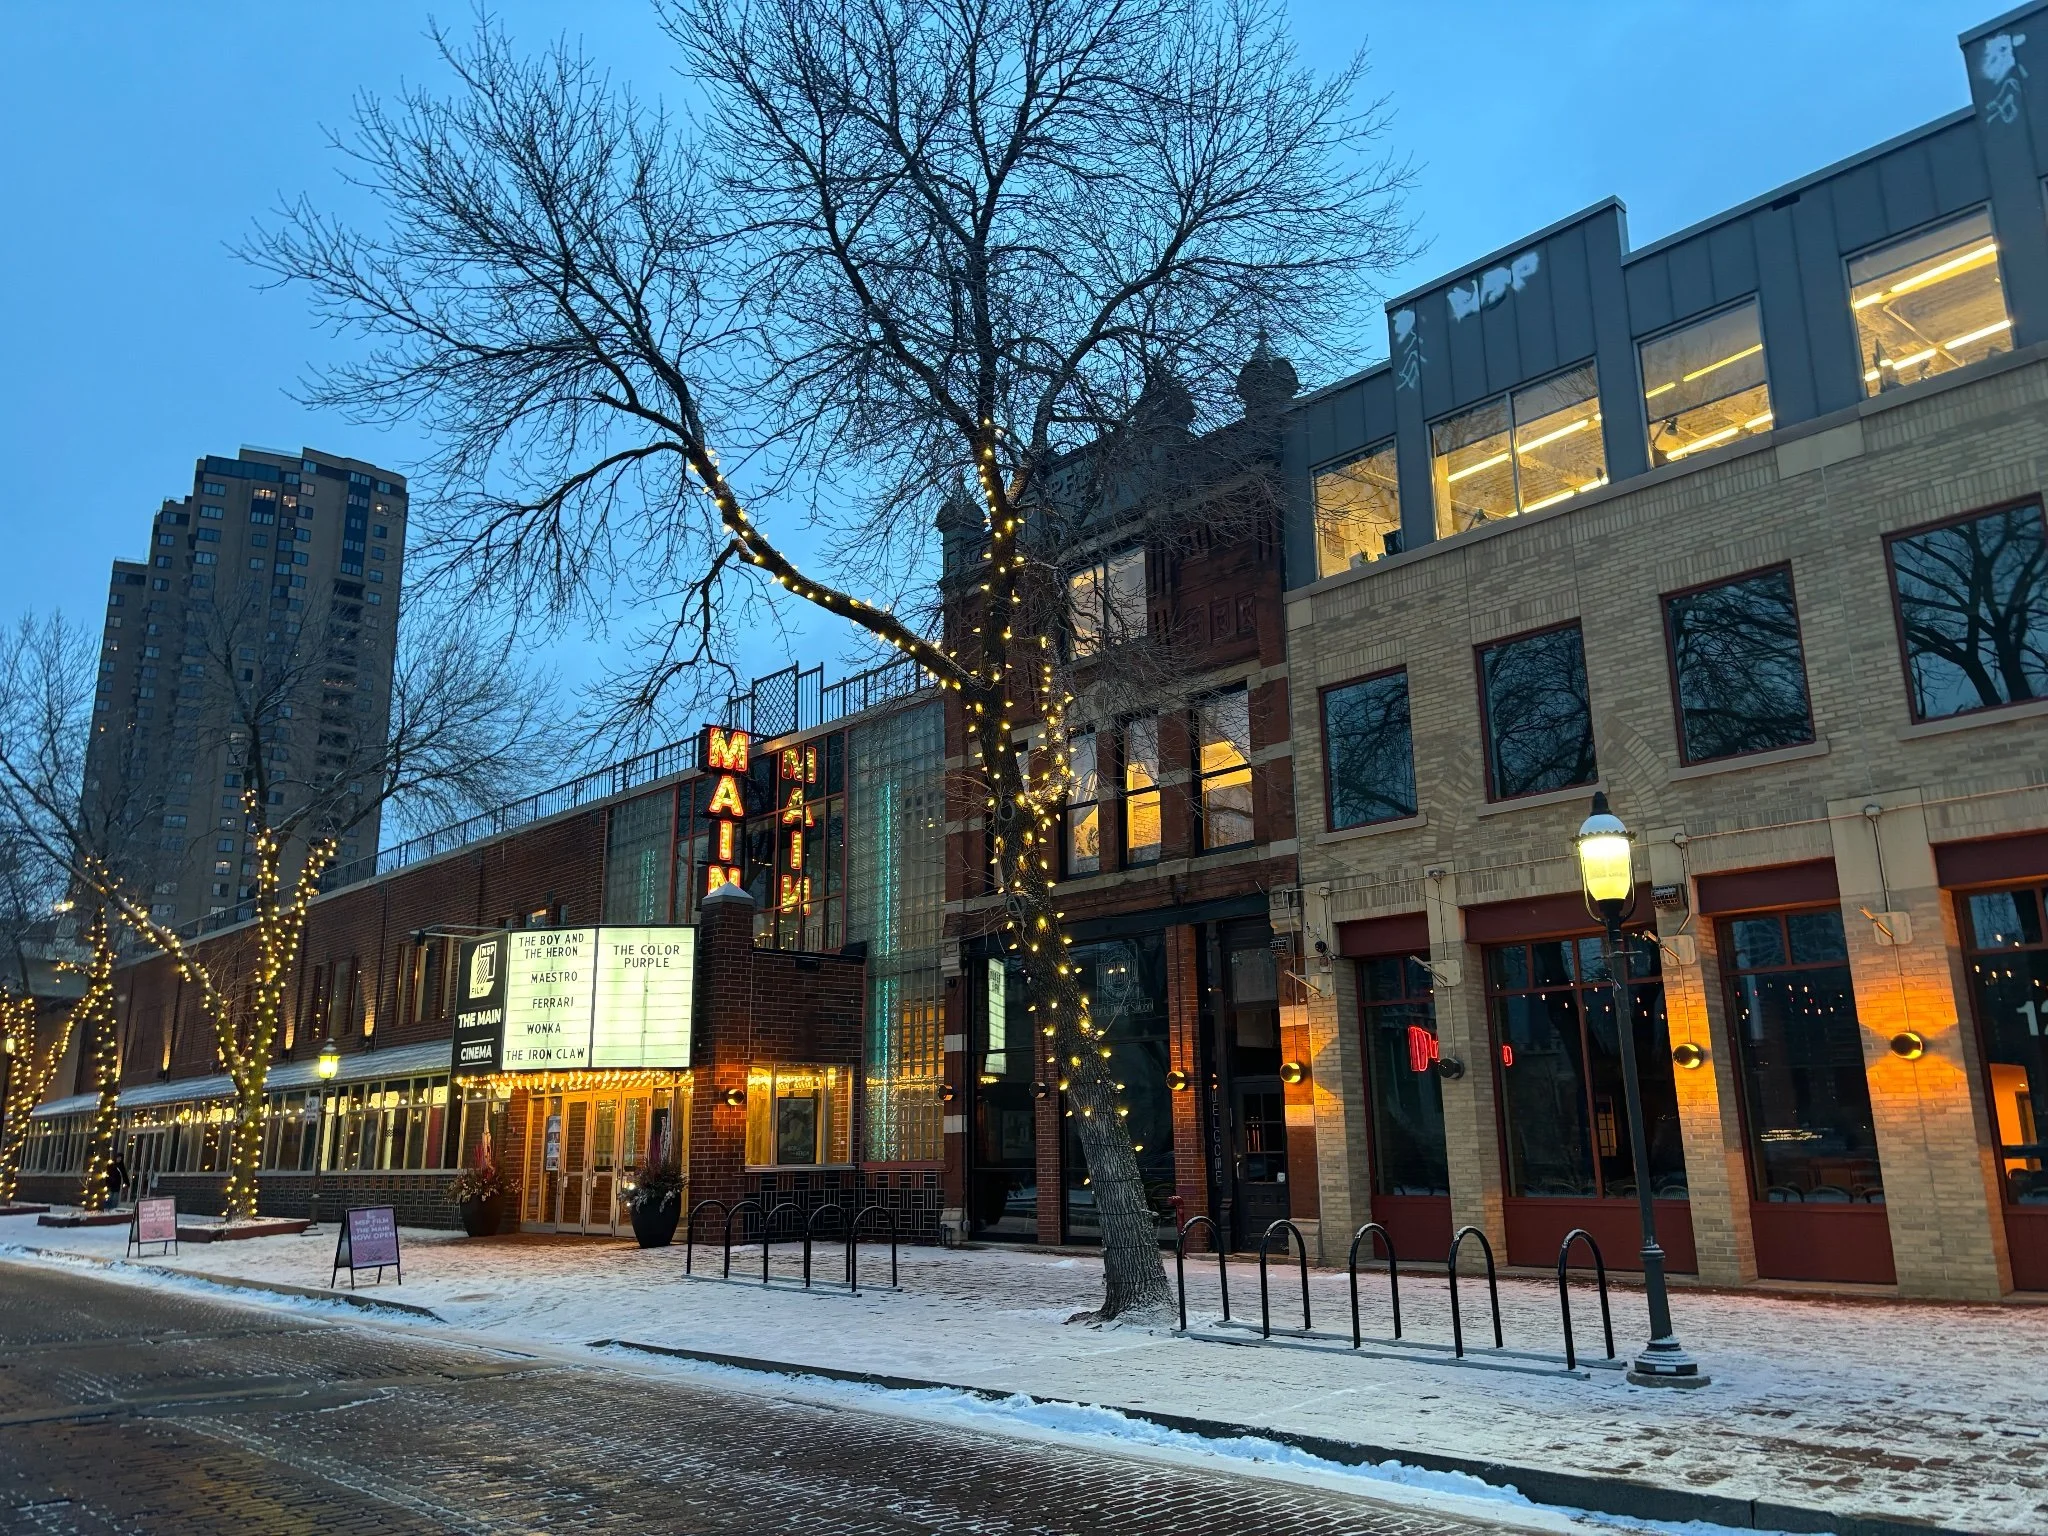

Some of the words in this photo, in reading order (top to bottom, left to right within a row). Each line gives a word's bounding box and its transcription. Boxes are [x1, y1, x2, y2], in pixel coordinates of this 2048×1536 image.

[707, 727, 749, 896] MAIN
[519, 936, 536, 947] THE
[540, 934, 561, 946] BOY
[564, 933, 584, 944] AND
[481, 946, 495, 957] MSP
[525, 948, 542, 959] THE
[546, 946, 578, 958] HERON
[613, 945, 634, 956] THE
[641, 945, 680, 956] COLOR
[624, 957, 670, 968] PURPLE
[531, 971, 578, 983] MAESTRO
[471, 987, 484, 995] FILM
[532, 997, 574, 1009] FERRARI
[458, 1012, 476, 1029] THE
[477, 1008, 502, 1026] MAIN
[527, 1023, 561, 1035] WONKA
[460, 1045, 492, 1061] CINEMA
[506, 1050, 523, 1060] THE
[528, 1049, 552, 1060] IRON
[556, 1047, 584, 1059] CLAW
[372, 1217, 389, 1225] FILM
[351, 1233, 371, 1241] NOW
[373, 1231, 395, 1240] OPEN
